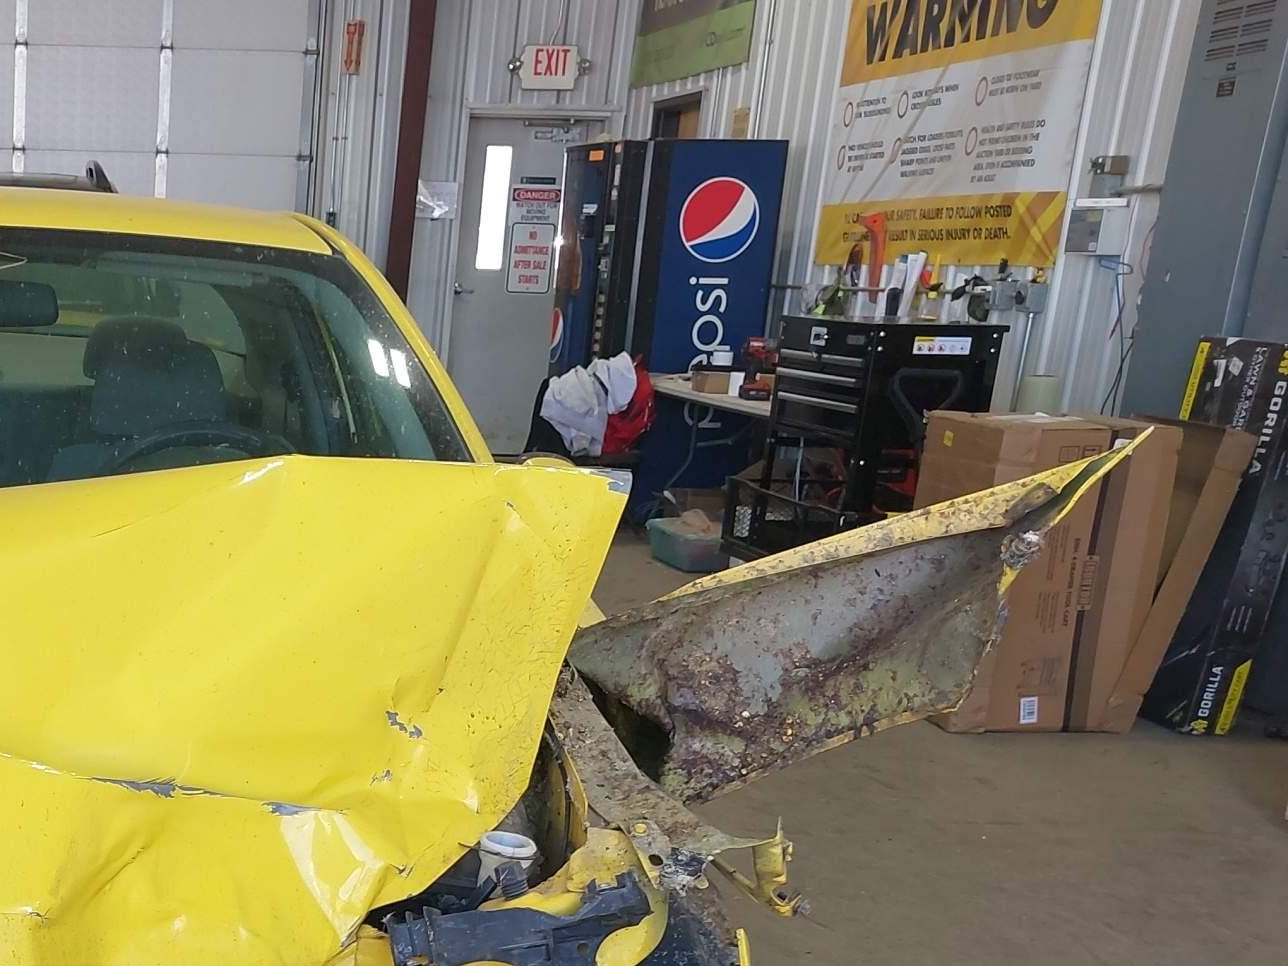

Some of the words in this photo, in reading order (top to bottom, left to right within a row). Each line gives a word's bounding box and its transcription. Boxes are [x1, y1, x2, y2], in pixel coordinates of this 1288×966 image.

[533, 48, 571, 76] EXIT
[1036, 119, 1046, 128] DO
[519, 191, 556, 200] DANGER
[919, 207, 944, 220] FAILURE
[945, 207, 954, 219] TO
[956, 206, 982, 219] FOLLOW
[984, 204, 1012, 218] POSTED
[918, 228, 944, 241] SERIOUS
[945, 228, 971, 241] INJURY
[972, 227, 983, 240] OR
[984, 226, 1011, 240] DEATH.
[514, 245, 550, 256] ADMITTANCE
[514, 260, 532, 270] AFTER
[1250, 347, 1268, 386] LAWN
[1248, 380, 1288, 474] GORILLA
[1198, 666, 1225, 718] GORILLA
